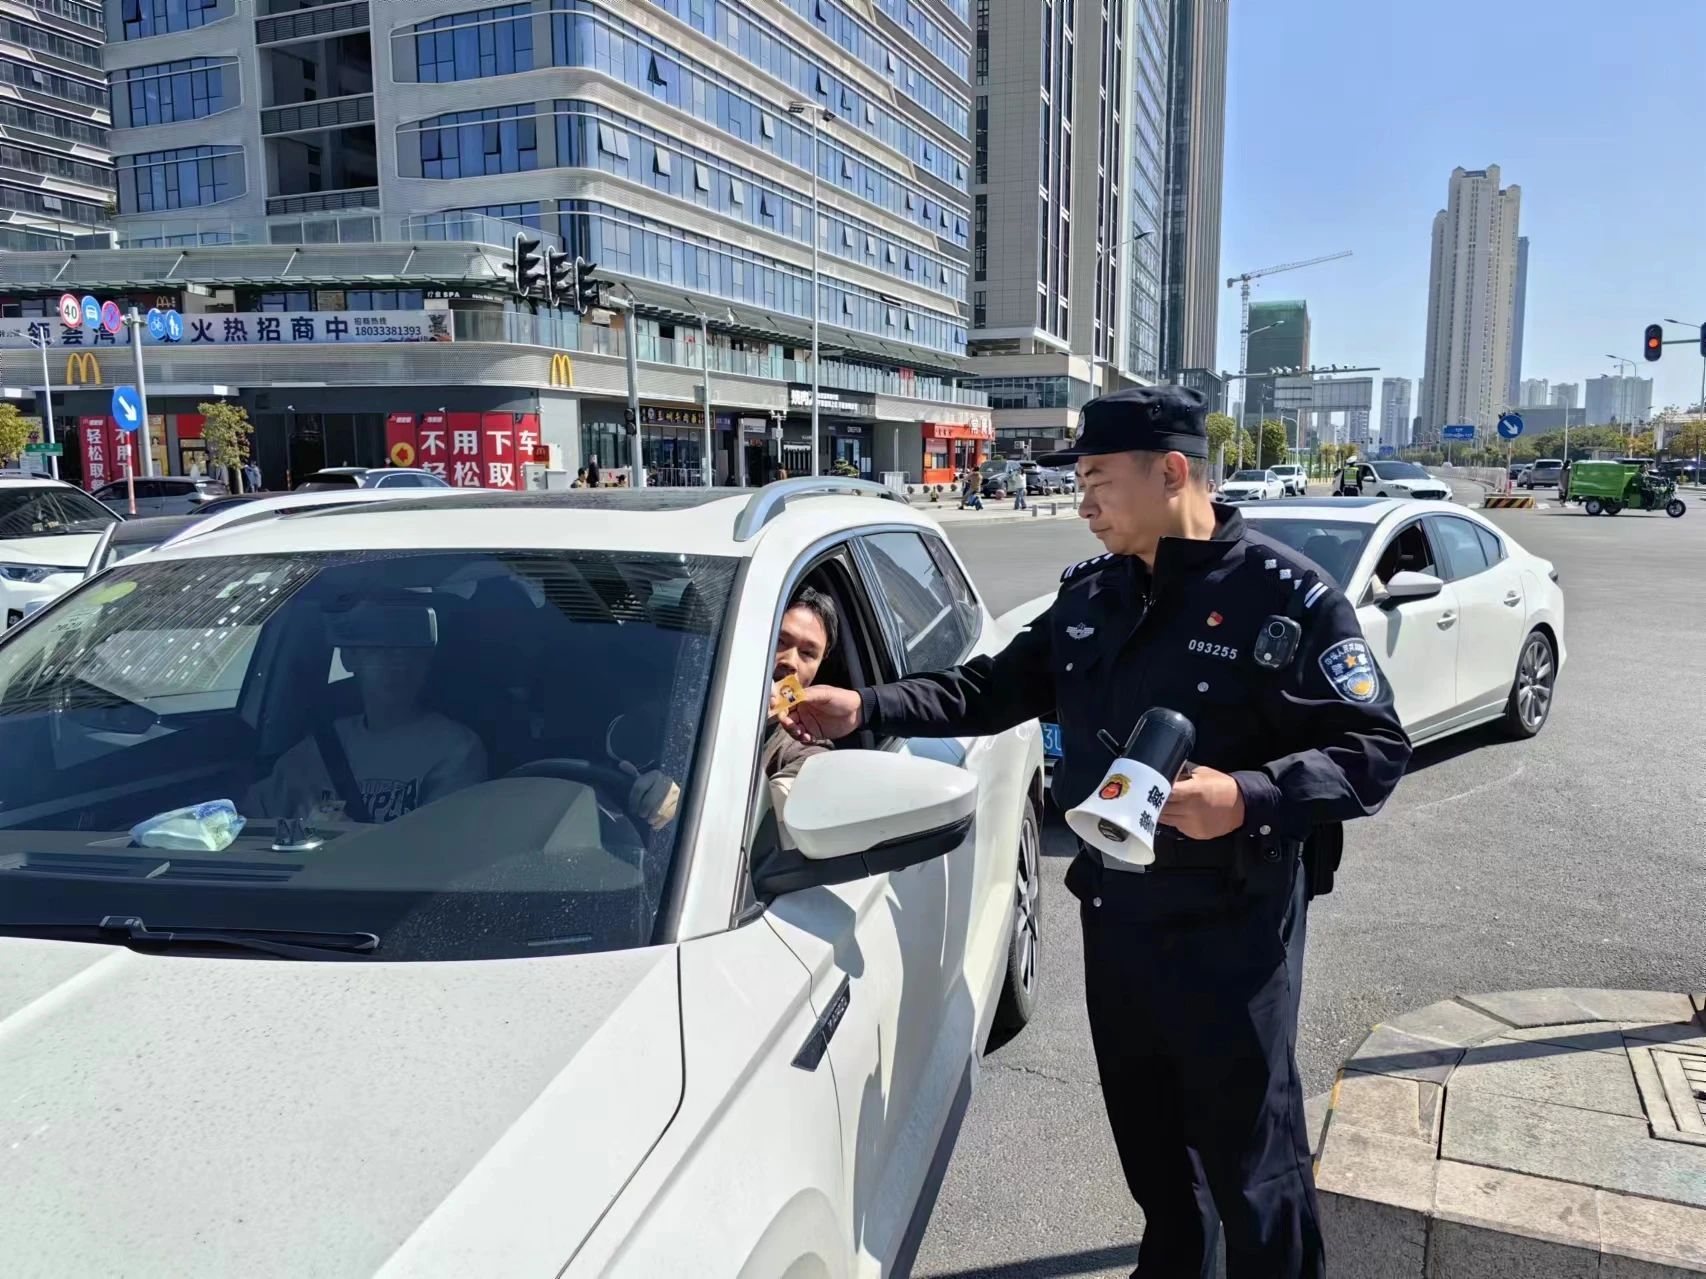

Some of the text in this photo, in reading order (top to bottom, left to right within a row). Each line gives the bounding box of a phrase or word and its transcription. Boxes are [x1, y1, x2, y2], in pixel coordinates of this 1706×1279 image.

[64, 304, 78, 319] 40
[354, 317, 387, 326] 招商热线
[355, 326, 422, 336] 18033381393
[421, 430, 538, 455] 不用下车
[1188, 639, 1238, 660] 093255
